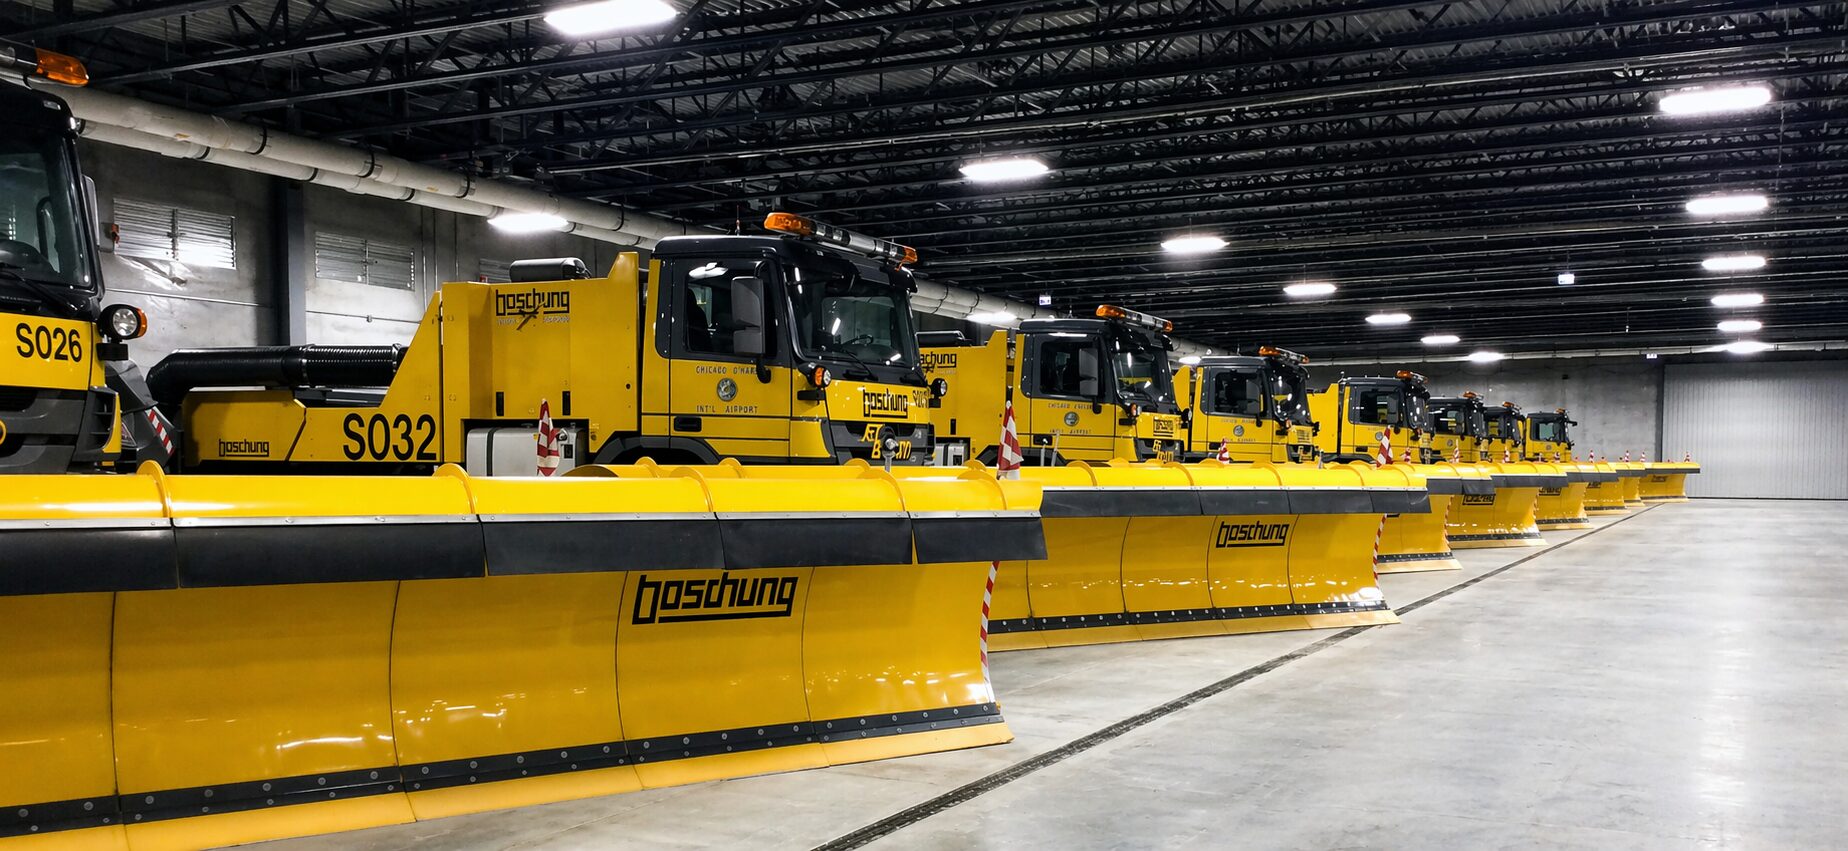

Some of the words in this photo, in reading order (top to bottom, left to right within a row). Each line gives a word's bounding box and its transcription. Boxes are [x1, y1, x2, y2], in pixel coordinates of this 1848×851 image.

[495, 287, 570, 316] boschung
[16, 323, 82, 362] S026
[696, 366, 727, 374] CHICAGO
[920, 351, 957, 368] schung
[697, 405, 716, 413] INT'L
[725, 405, 758, 413] AIRPORT
[863, 386, 908, 418] boschung
[219, 438, 269, 457] boschung
[342, 412, 437, 461] S032
[1216, 521, 1289, 548] boschung
[632, 572, 799, 625] boschung
